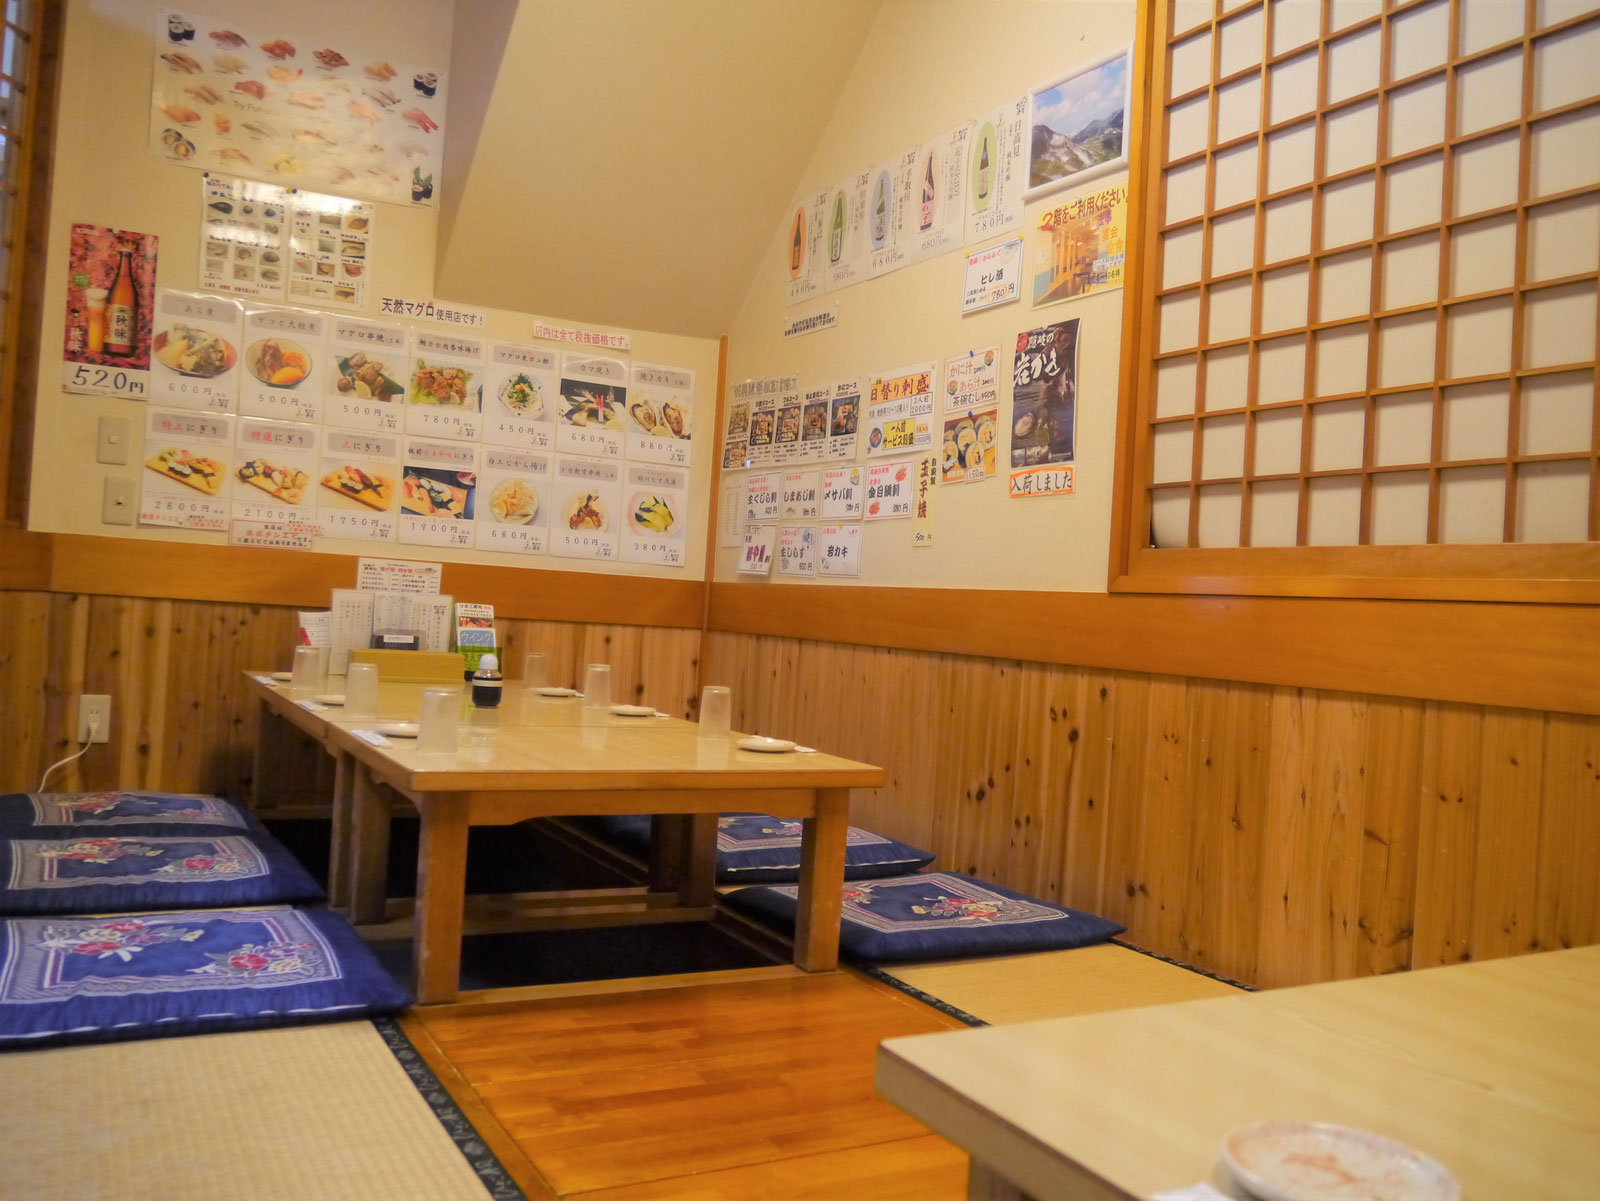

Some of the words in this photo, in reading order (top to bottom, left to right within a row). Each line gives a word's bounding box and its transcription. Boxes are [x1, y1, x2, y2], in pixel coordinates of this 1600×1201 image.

[233, 100, 245, 111] Try
[1013, 119, 1022, 158] 日高見
[975, 213, 1004, 233] 780円
[381, 297, 484, 326] 天然マグロ使用店です！
[72, 365, 144, 393] 520円
[959, 376, 982, 392] あら汁
[168, 383, 212, 396] 600円
[871, 374, 929, 401] 日替り刺盛
[258, 393, 300, 407] 500円
[343, 404, 382, 417] 500円
[423, 414, 460, 426] 780円
[161, 420, 217, 436] 特上にぎり
[499, 424, 535, 435] 450円
[342, 441, 382, 453] 上にぎり
[917, 459, 929, 519] 玉子焼
[1011, 471, 1072, 495] 入荷しました
[154, 501, 210, 513] 2800円
[244, 508, 297, 520] 2100円
[330, 515, 380, 528] 1750円
[411, 522, 458, 533] 1900円
[491, 530, 527, 540] 680円
[565, 536, 599, 546] 500円
[634, 542, 667, 553] 380円
[827, 544, 848, 558] 岩カキ
